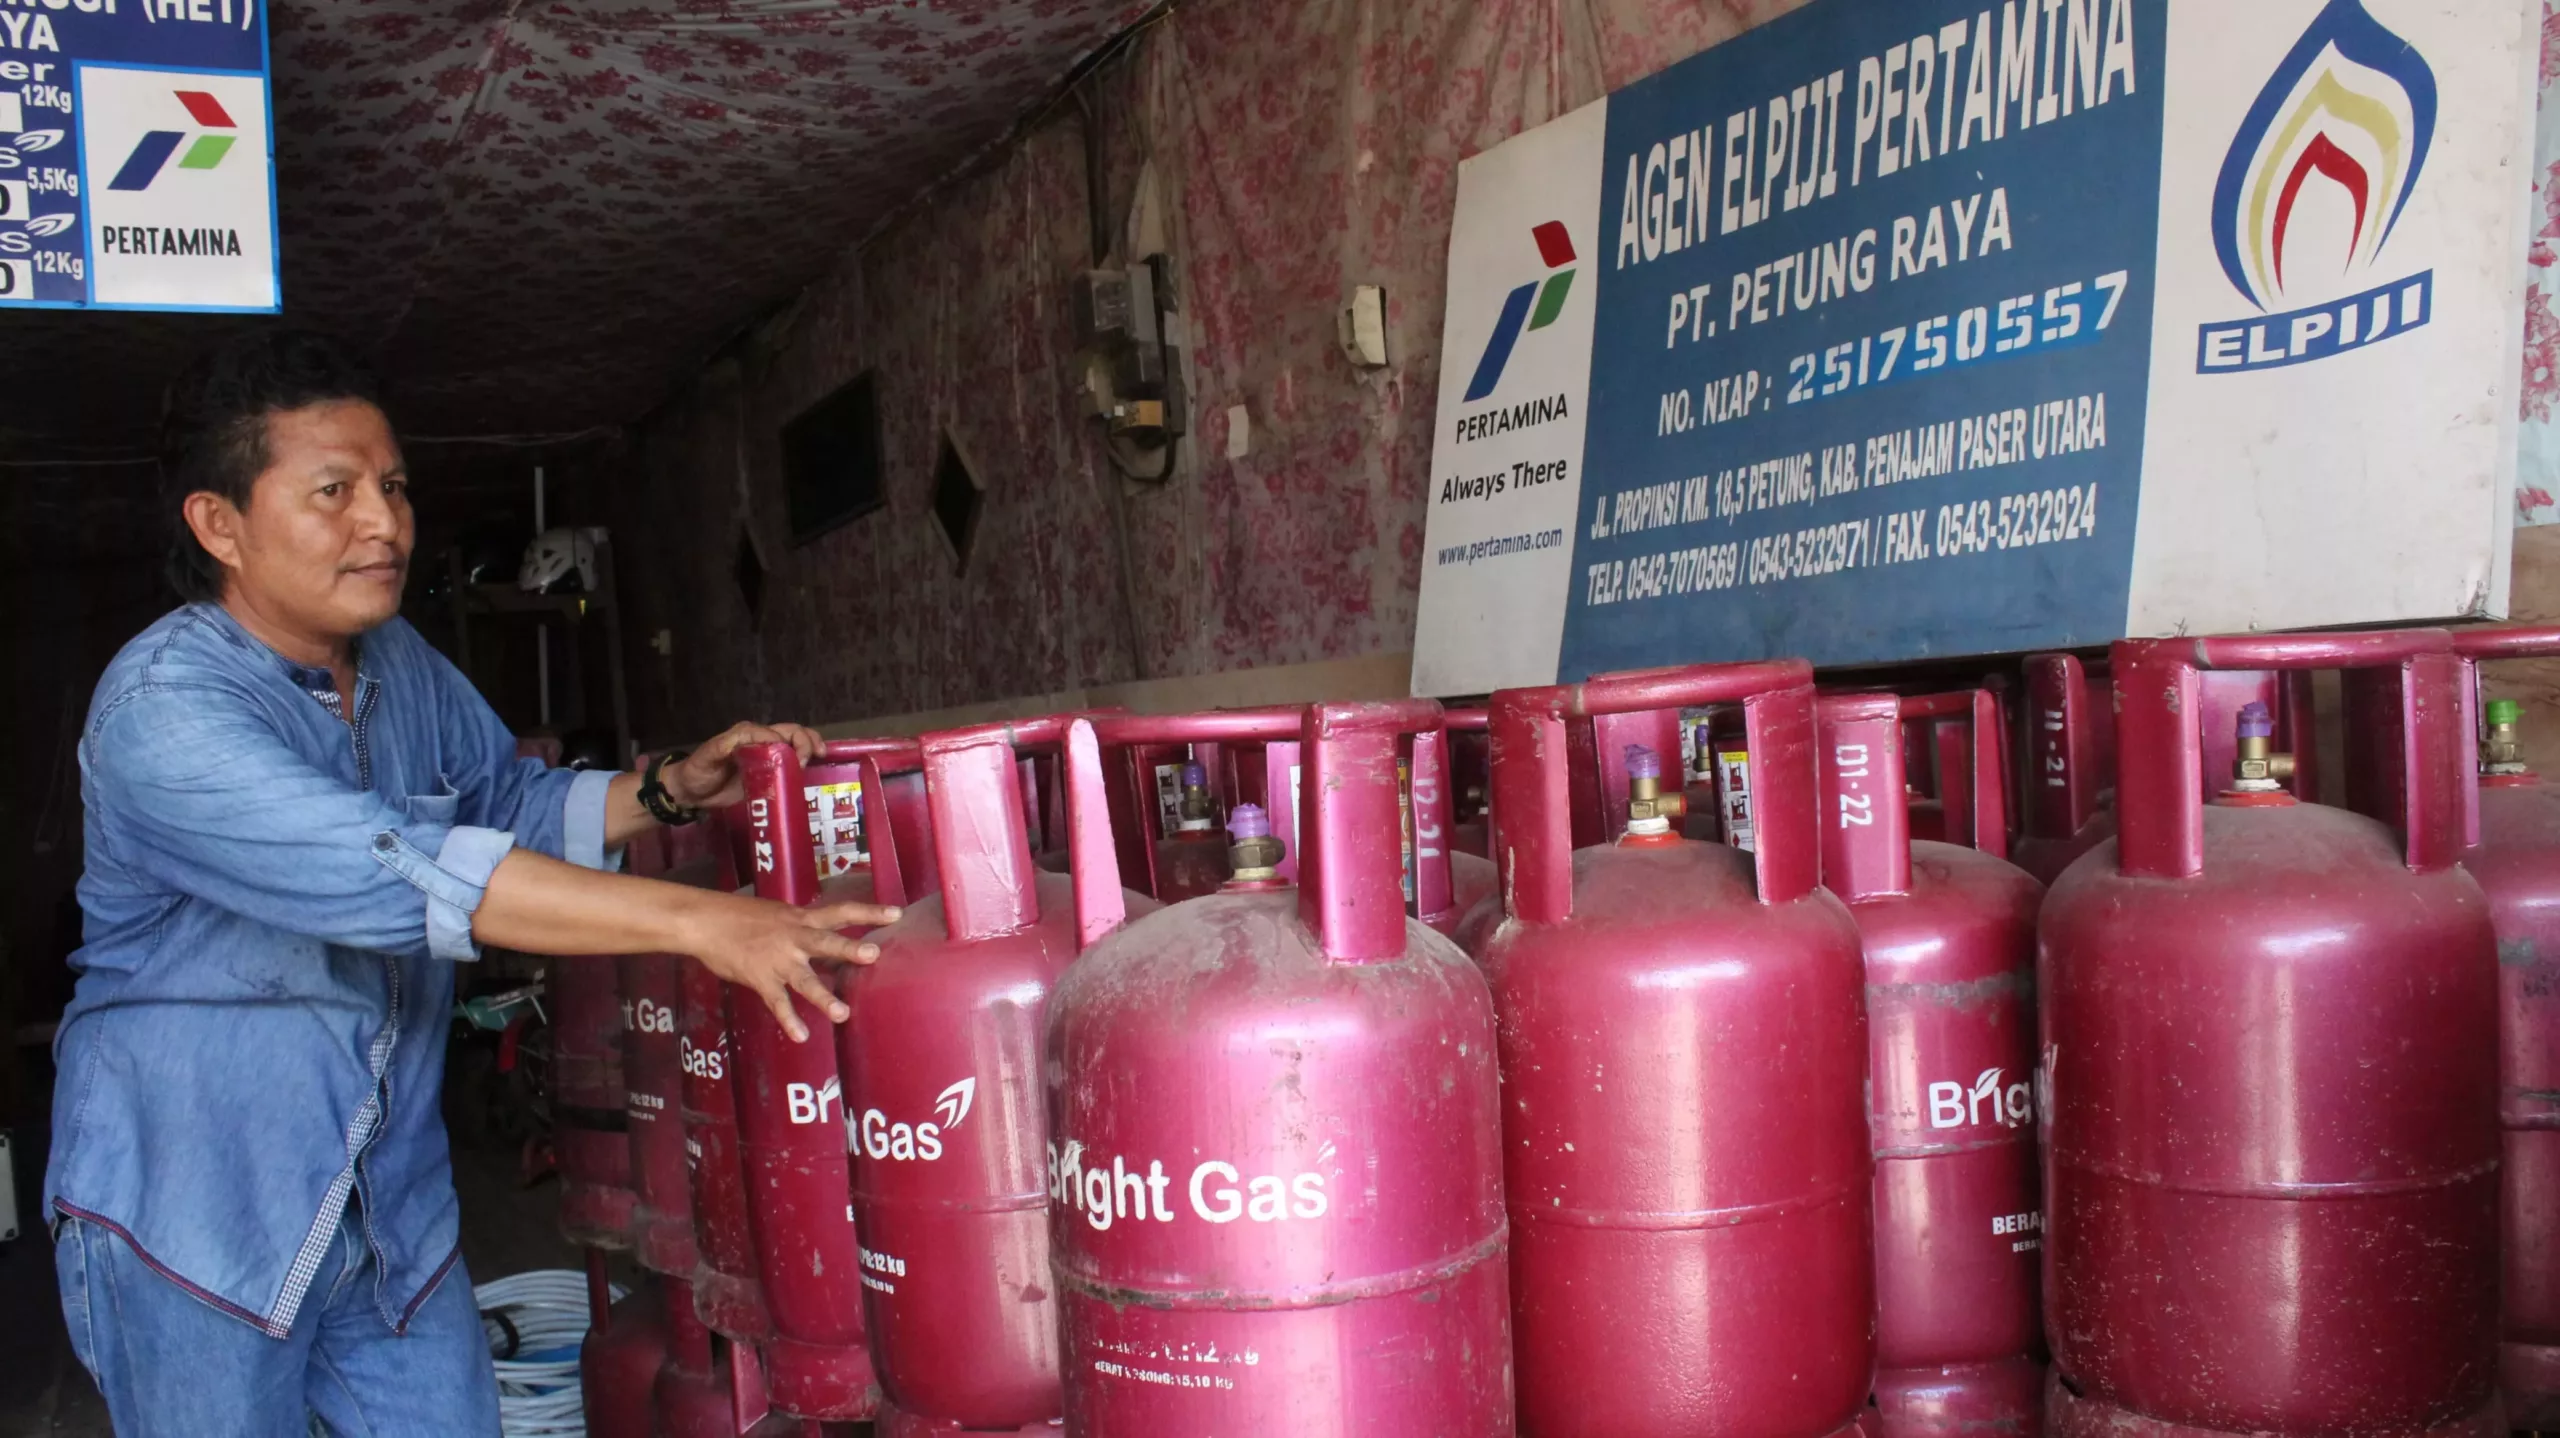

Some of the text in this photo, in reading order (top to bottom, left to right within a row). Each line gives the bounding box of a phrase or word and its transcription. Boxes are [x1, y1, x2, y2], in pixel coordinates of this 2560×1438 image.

[0, 10, 60, 52] YA
[21, 84, 72, 113] 12Kg
[1617, 0, 2136, 270] AGEN ELPIJI PERTAMINA
[27, 167, 79, 197] 5,5Kg
[102, 226, 242, 256] PERTAMINA
[33, 251, 84, 280] 12Kg
[1667, 187, 2012, 349] PT. PETUNG RAYA
[2204, 283, 2422, 367] ELPIJI
[1456, 393, 1568, 444] PERTAMINA
[1658, 389, 1695, 437] NO.
[1440, 458, 1567, 504] Always There
[1591, 392, 2106, 540] JL. PROPINSI KM. 18,5 PETUNG, KAB. PENAJAM PASER UTARA
[1438, 528, 1563, 567] www.pertamina.com
[1587, 560, 1624, 606] TELP.
[1626, 542, 1737, 601] 0542-7070569
[1749, 518, 1870, 586] 0543-5232971
[1885, 509, 1929, 564] FAX.
[1936, 482, 2098, 558] 0543-5232924
[680, 1035, 724, 1080] Gas
[862, 1108, 943, 1162] Gas
[1047, 1139, 1328, 1231] Bright Gas
[1991, 1210, 2042, 1236] BERA
